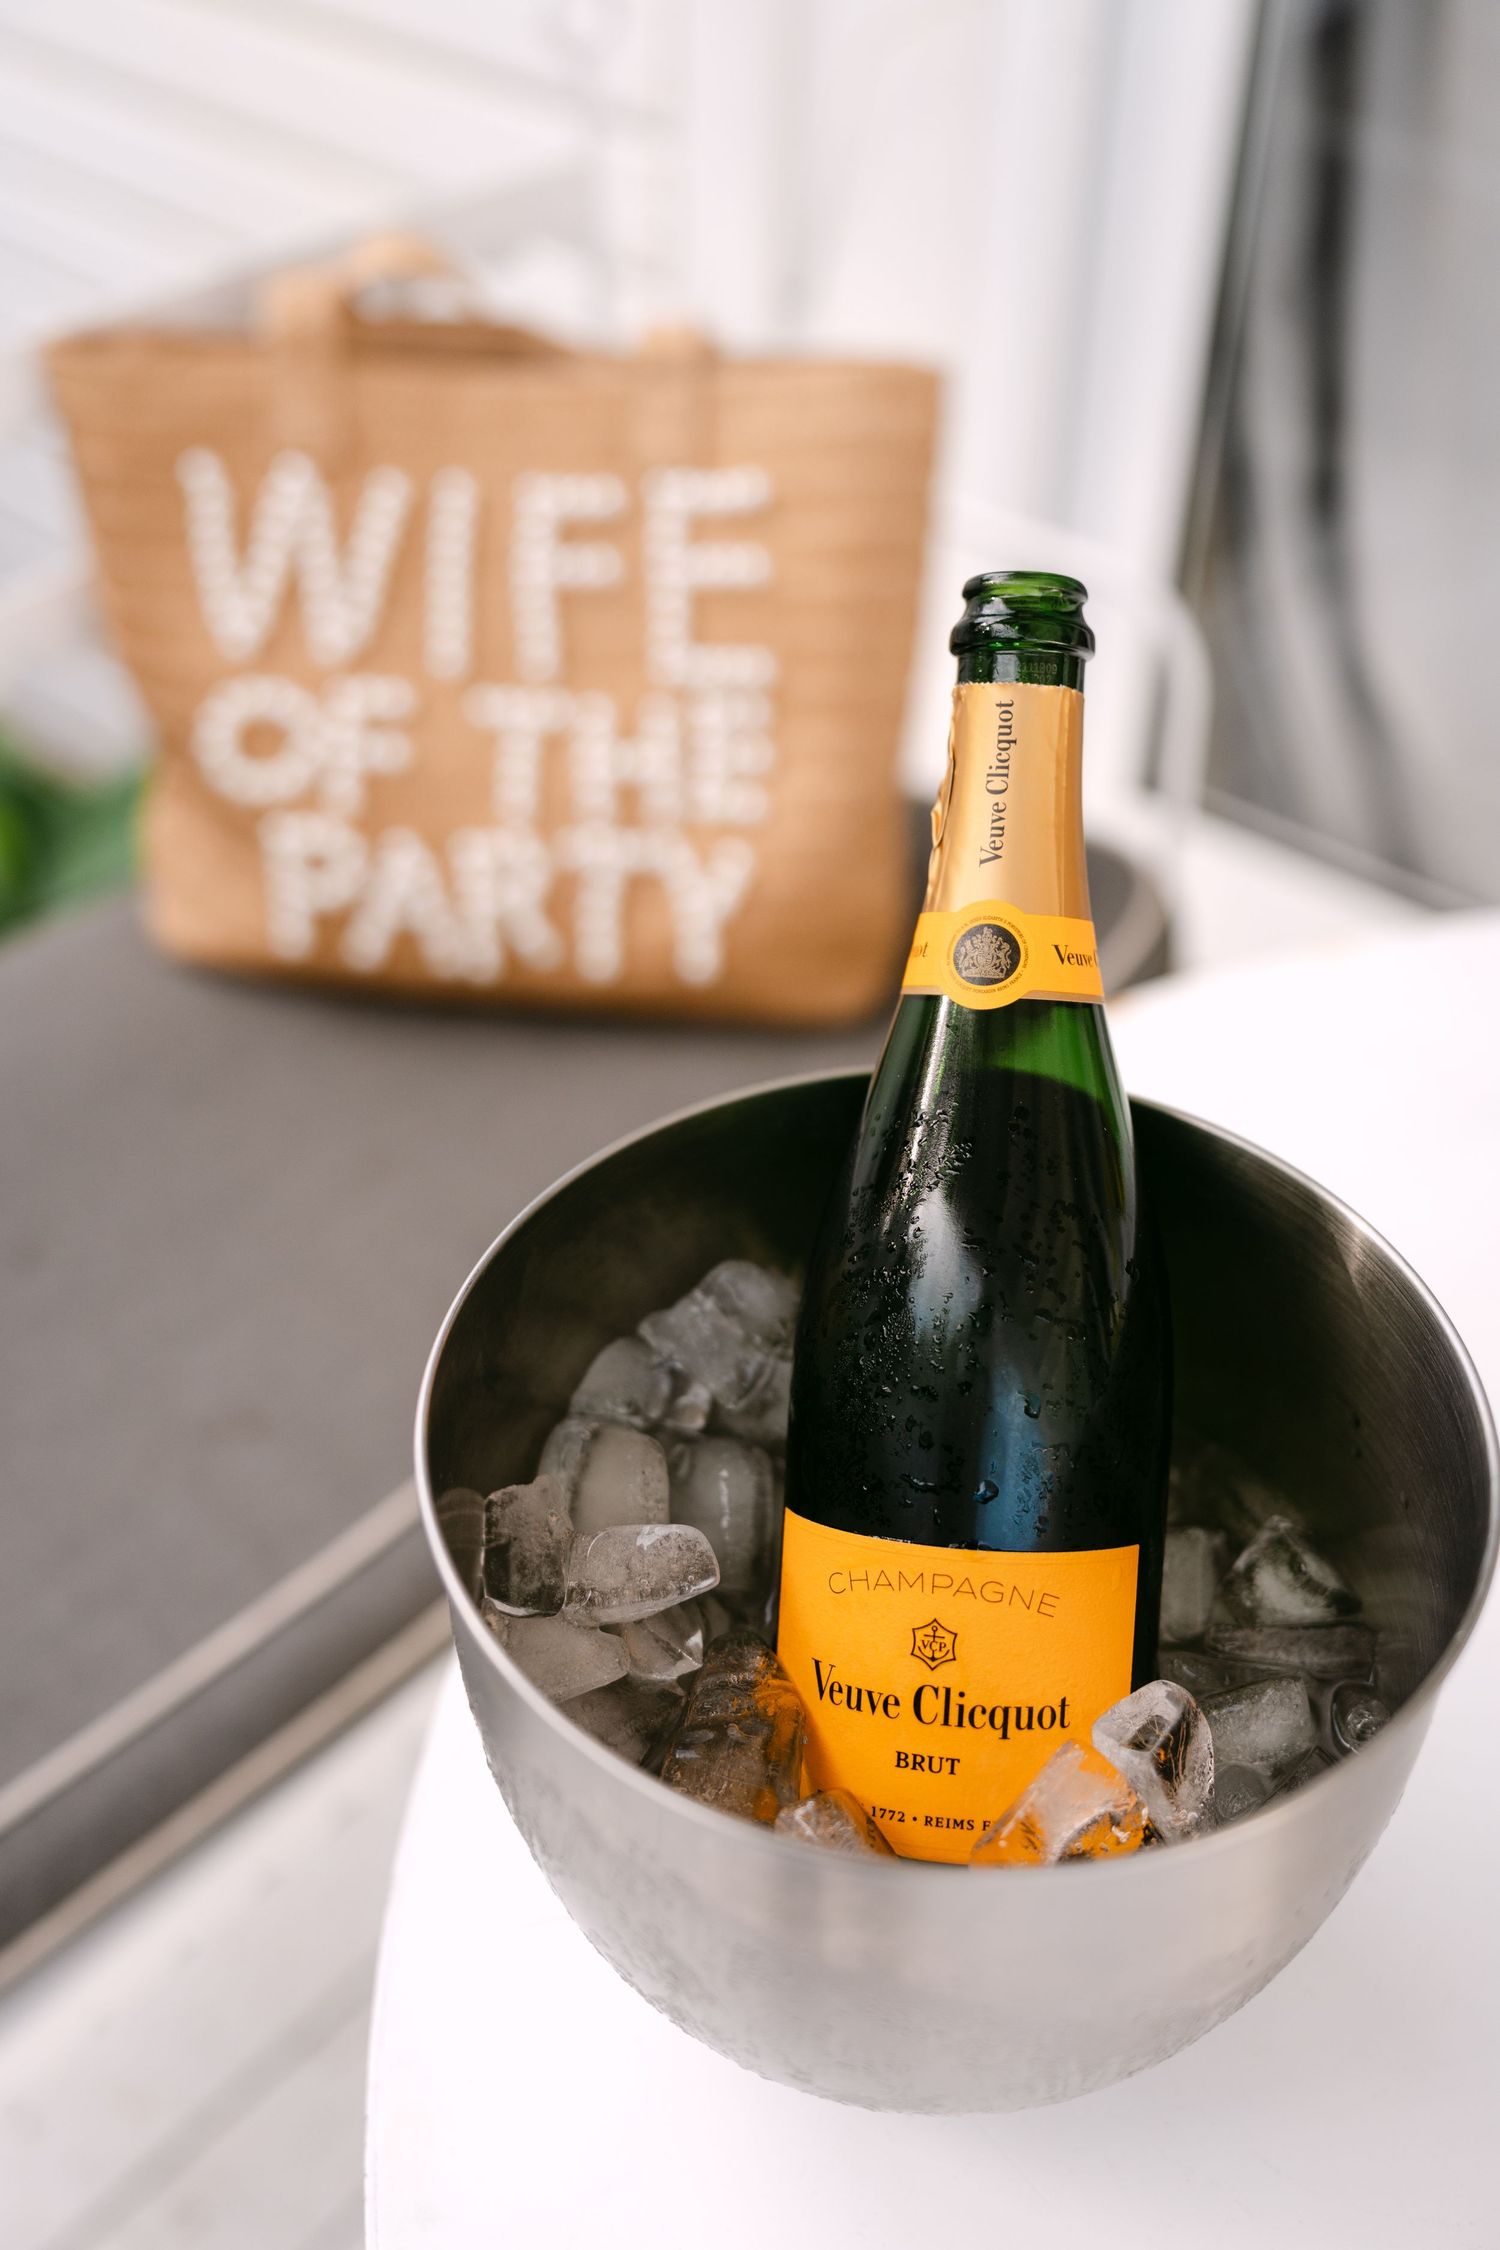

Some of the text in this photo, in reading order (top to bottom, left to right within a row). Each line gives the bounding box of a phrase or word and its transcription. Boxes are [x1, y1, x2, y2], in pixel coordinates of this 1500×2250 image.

[176, 446, 778, 686] WIFE
[192, 675, 778, 828] OF THE
[978, 699, 1018, 868] Veuve Clicquot
[259, 809, 758, 986] PARTY
[1051, 943, 1093, 968] Veuve
[828, 1569, 1061, 1619] CHAMPAGNE
[920, 1639, 947, 1653] VCP
[811, 1657, 1071, 1740] Veuve Clicquot
[894, 1750, 961, 1777] BRUT
[871, 1805, 906, 1823] 1772
[924, 1815, 975, 1832] REIMS
